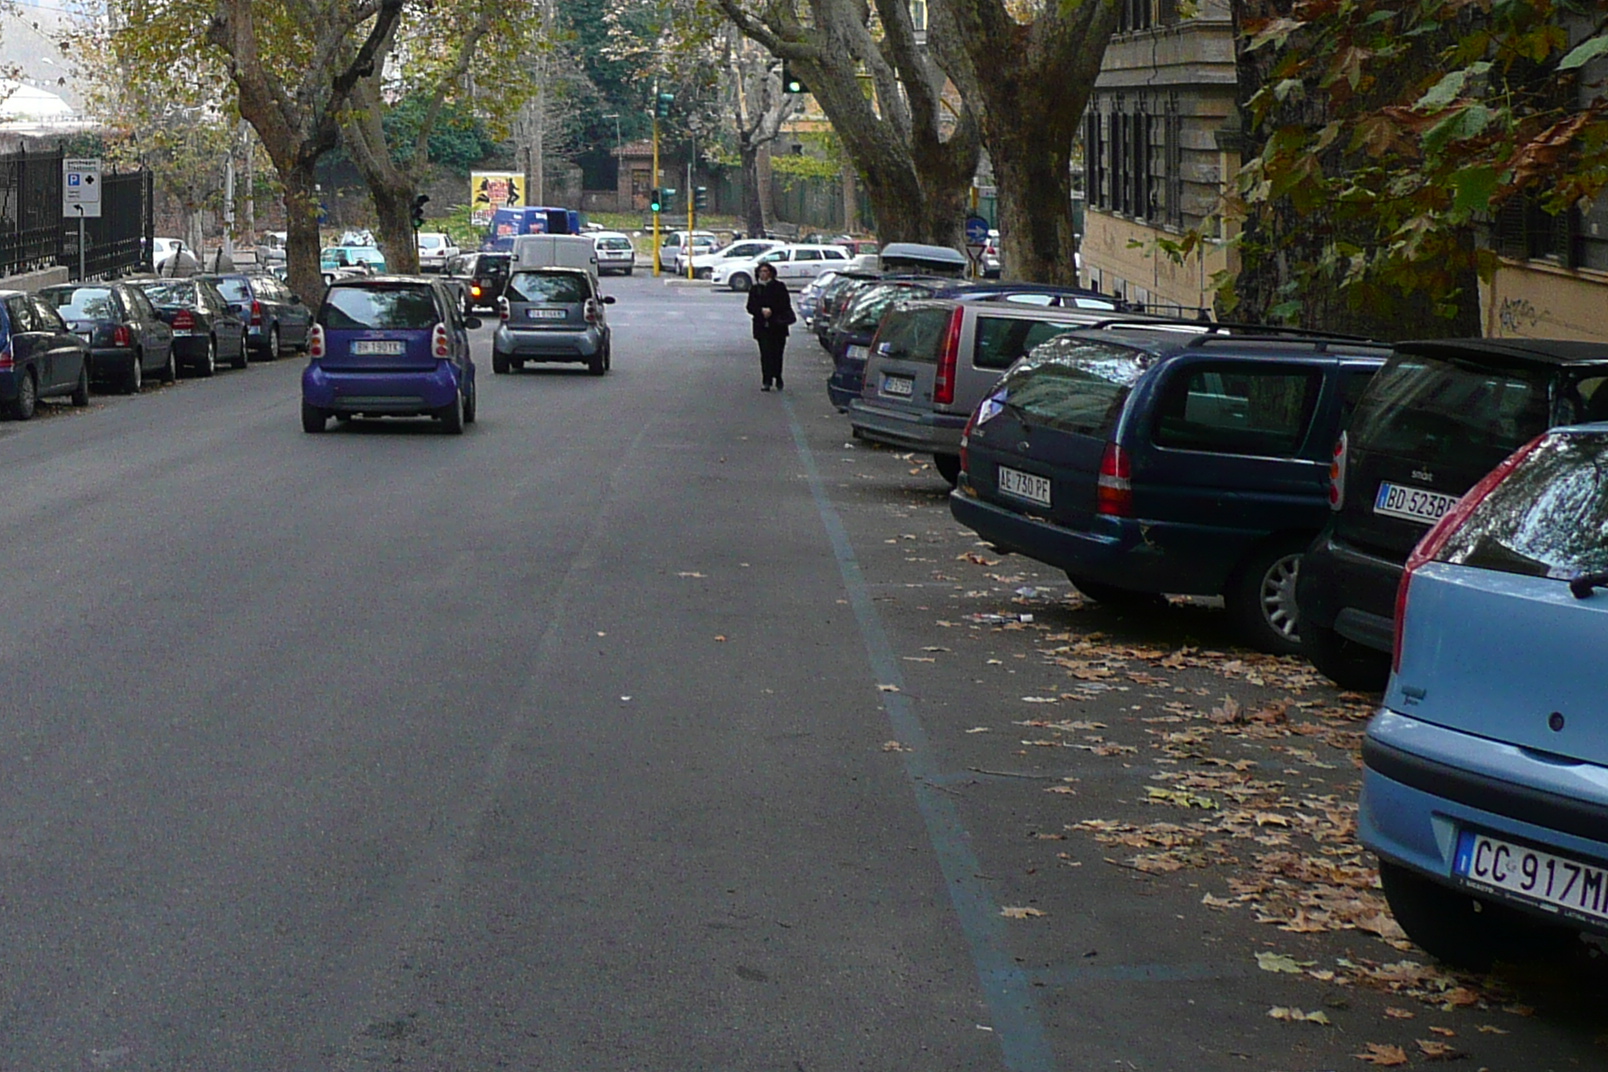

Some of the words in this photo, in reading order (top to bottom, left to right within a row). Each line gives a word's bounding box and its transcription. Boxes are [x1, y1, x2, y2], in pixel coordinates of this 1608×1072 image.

[69, 175, 78, 185] P
[1000, 469, 1012, 490] AE
[1016, 473, 1034, 496] 730
[1036, 479, 1048, 499] PF
[1411, 469, 1433, 482] smart
[1387, 487, 1406, 510] BD
[1474, 839, 1511, 882] CC
[1519, 853, 1608, 914] 917M
